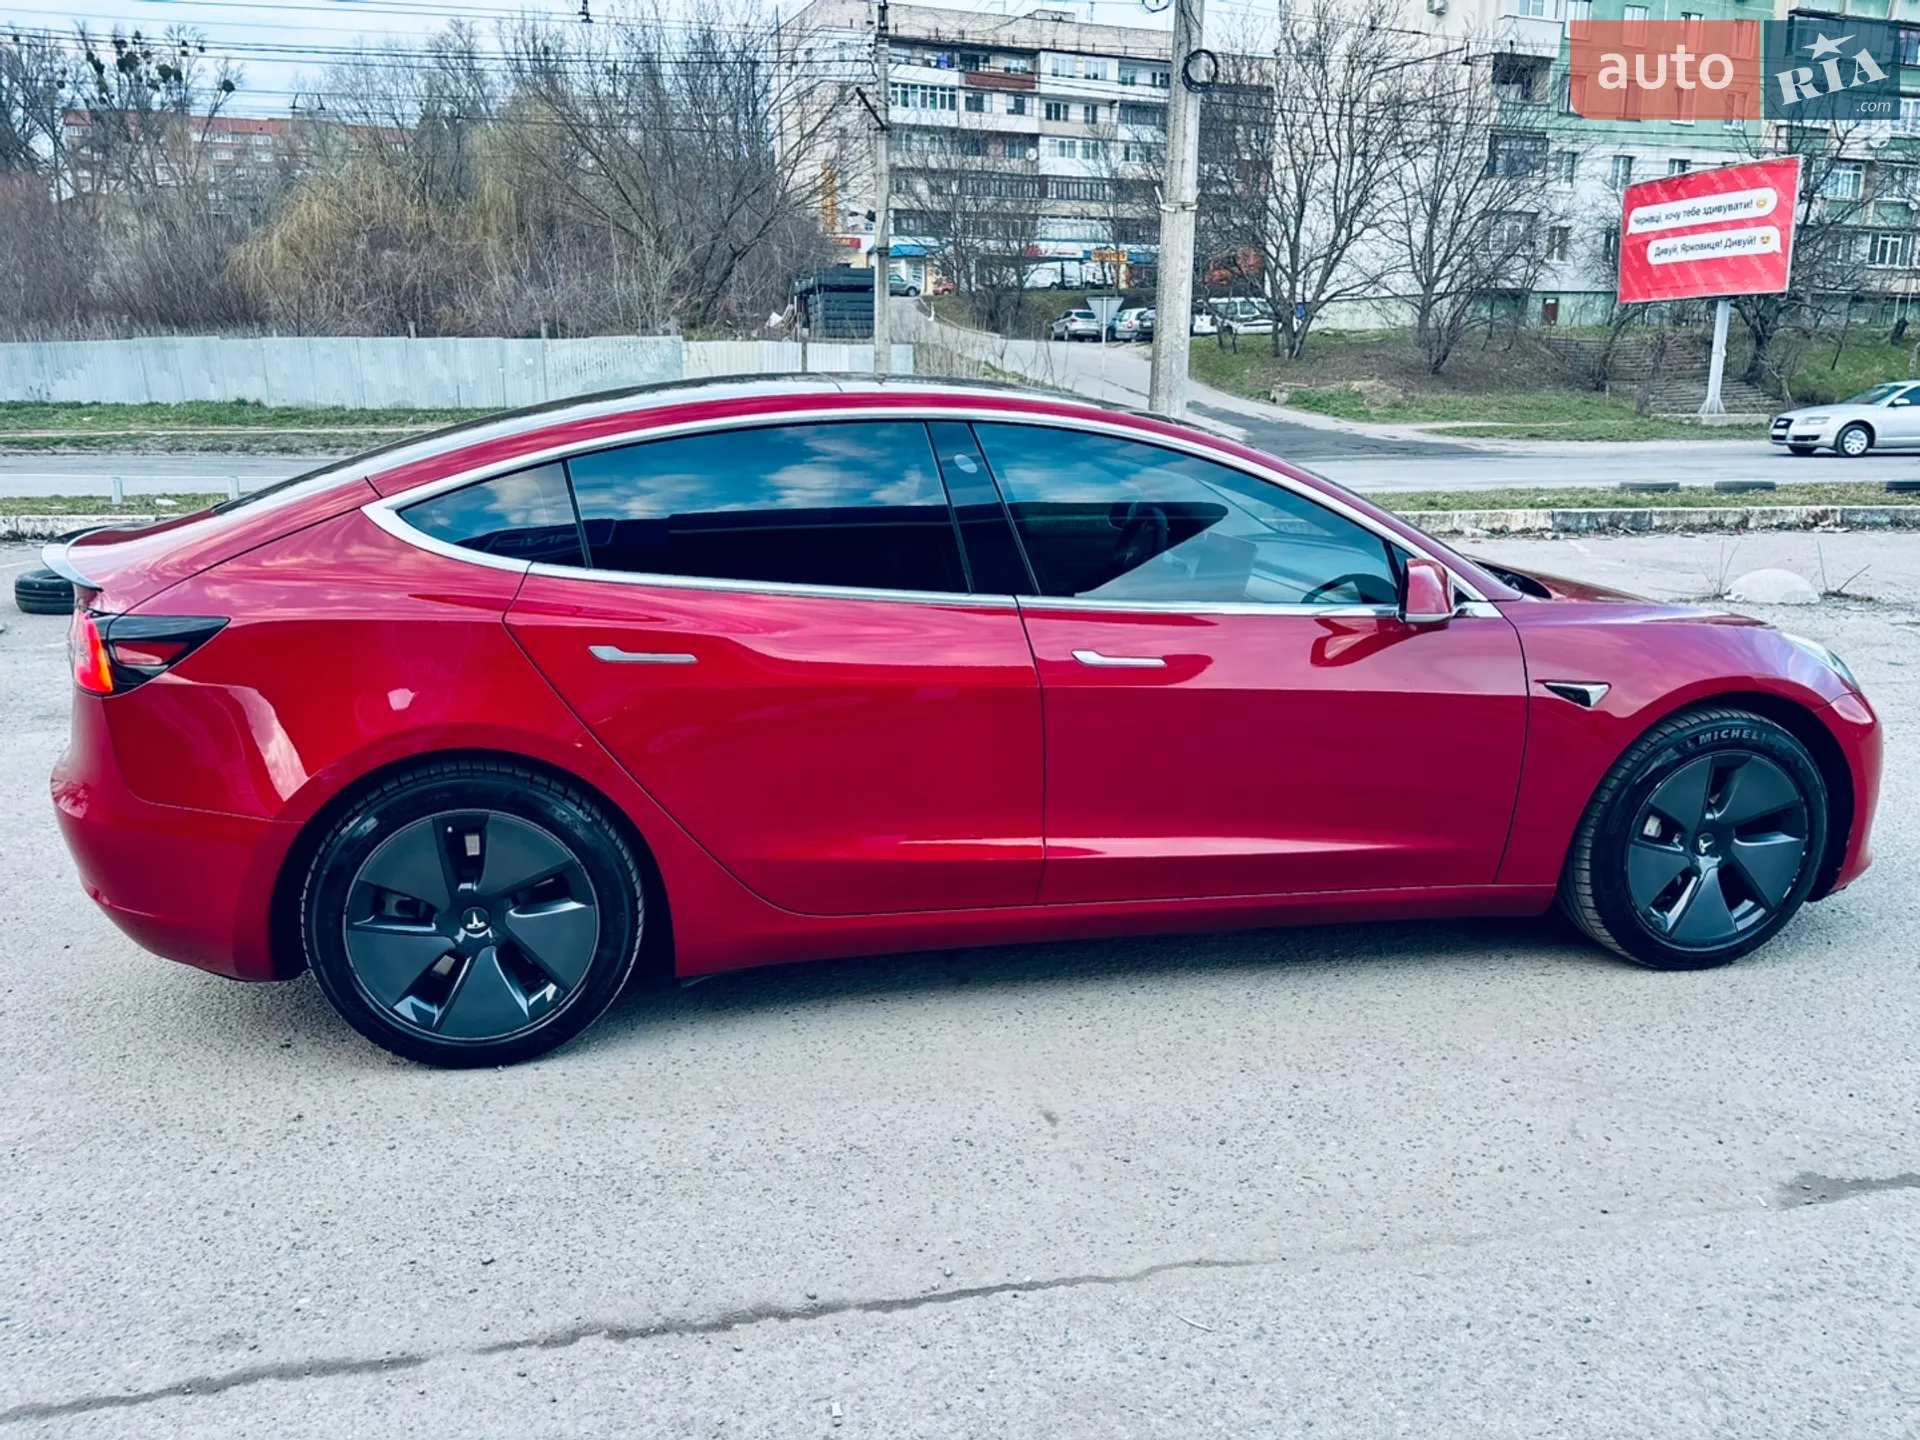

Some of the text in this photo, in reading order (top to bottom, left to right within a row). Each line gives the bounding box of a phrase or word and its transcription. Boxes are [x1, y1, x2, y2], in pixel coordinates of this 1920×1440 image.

[1683, 206, 1701, 218] тебе
[1702, 200, 1754, 216] здивувати!
[1724, 236, 1757, 249] Дивуй!
